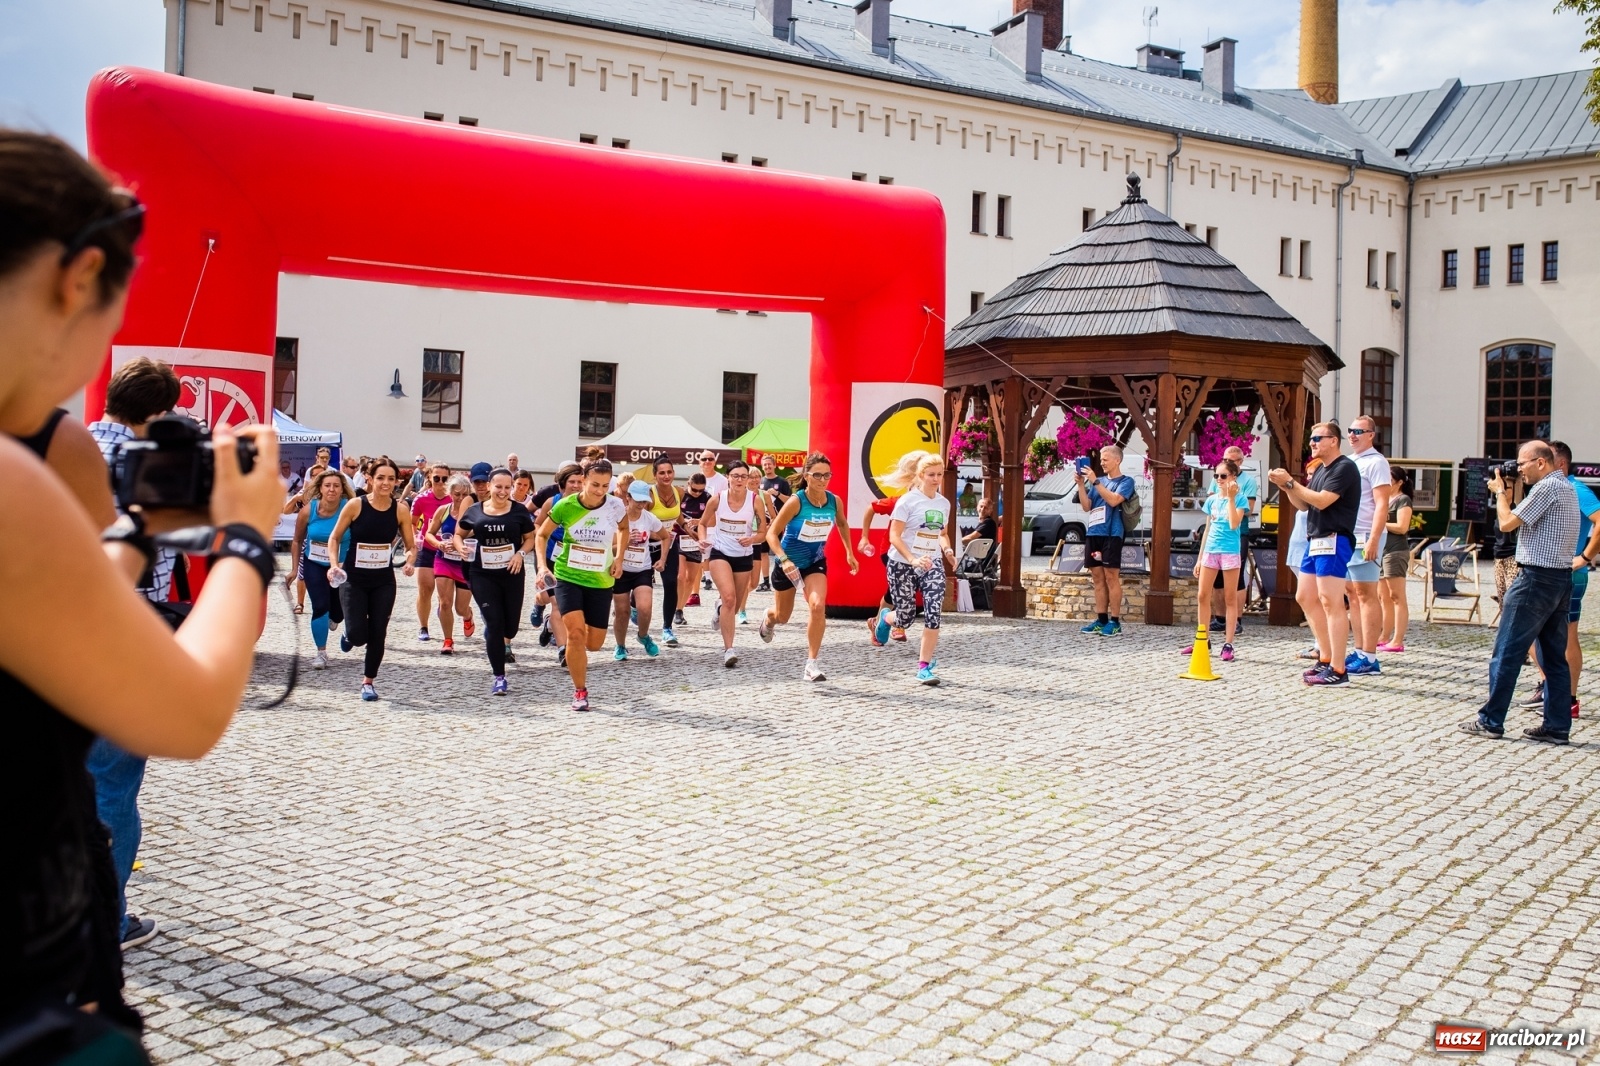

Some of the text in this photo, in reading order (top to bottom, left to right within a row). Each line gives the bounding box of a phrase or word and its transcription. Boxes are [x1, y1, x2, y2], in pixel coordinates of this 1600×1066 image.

[369, 552, 379, 560] 42
[494, 554, 503, 562] 29
[582, 554, 592, 562] 30
